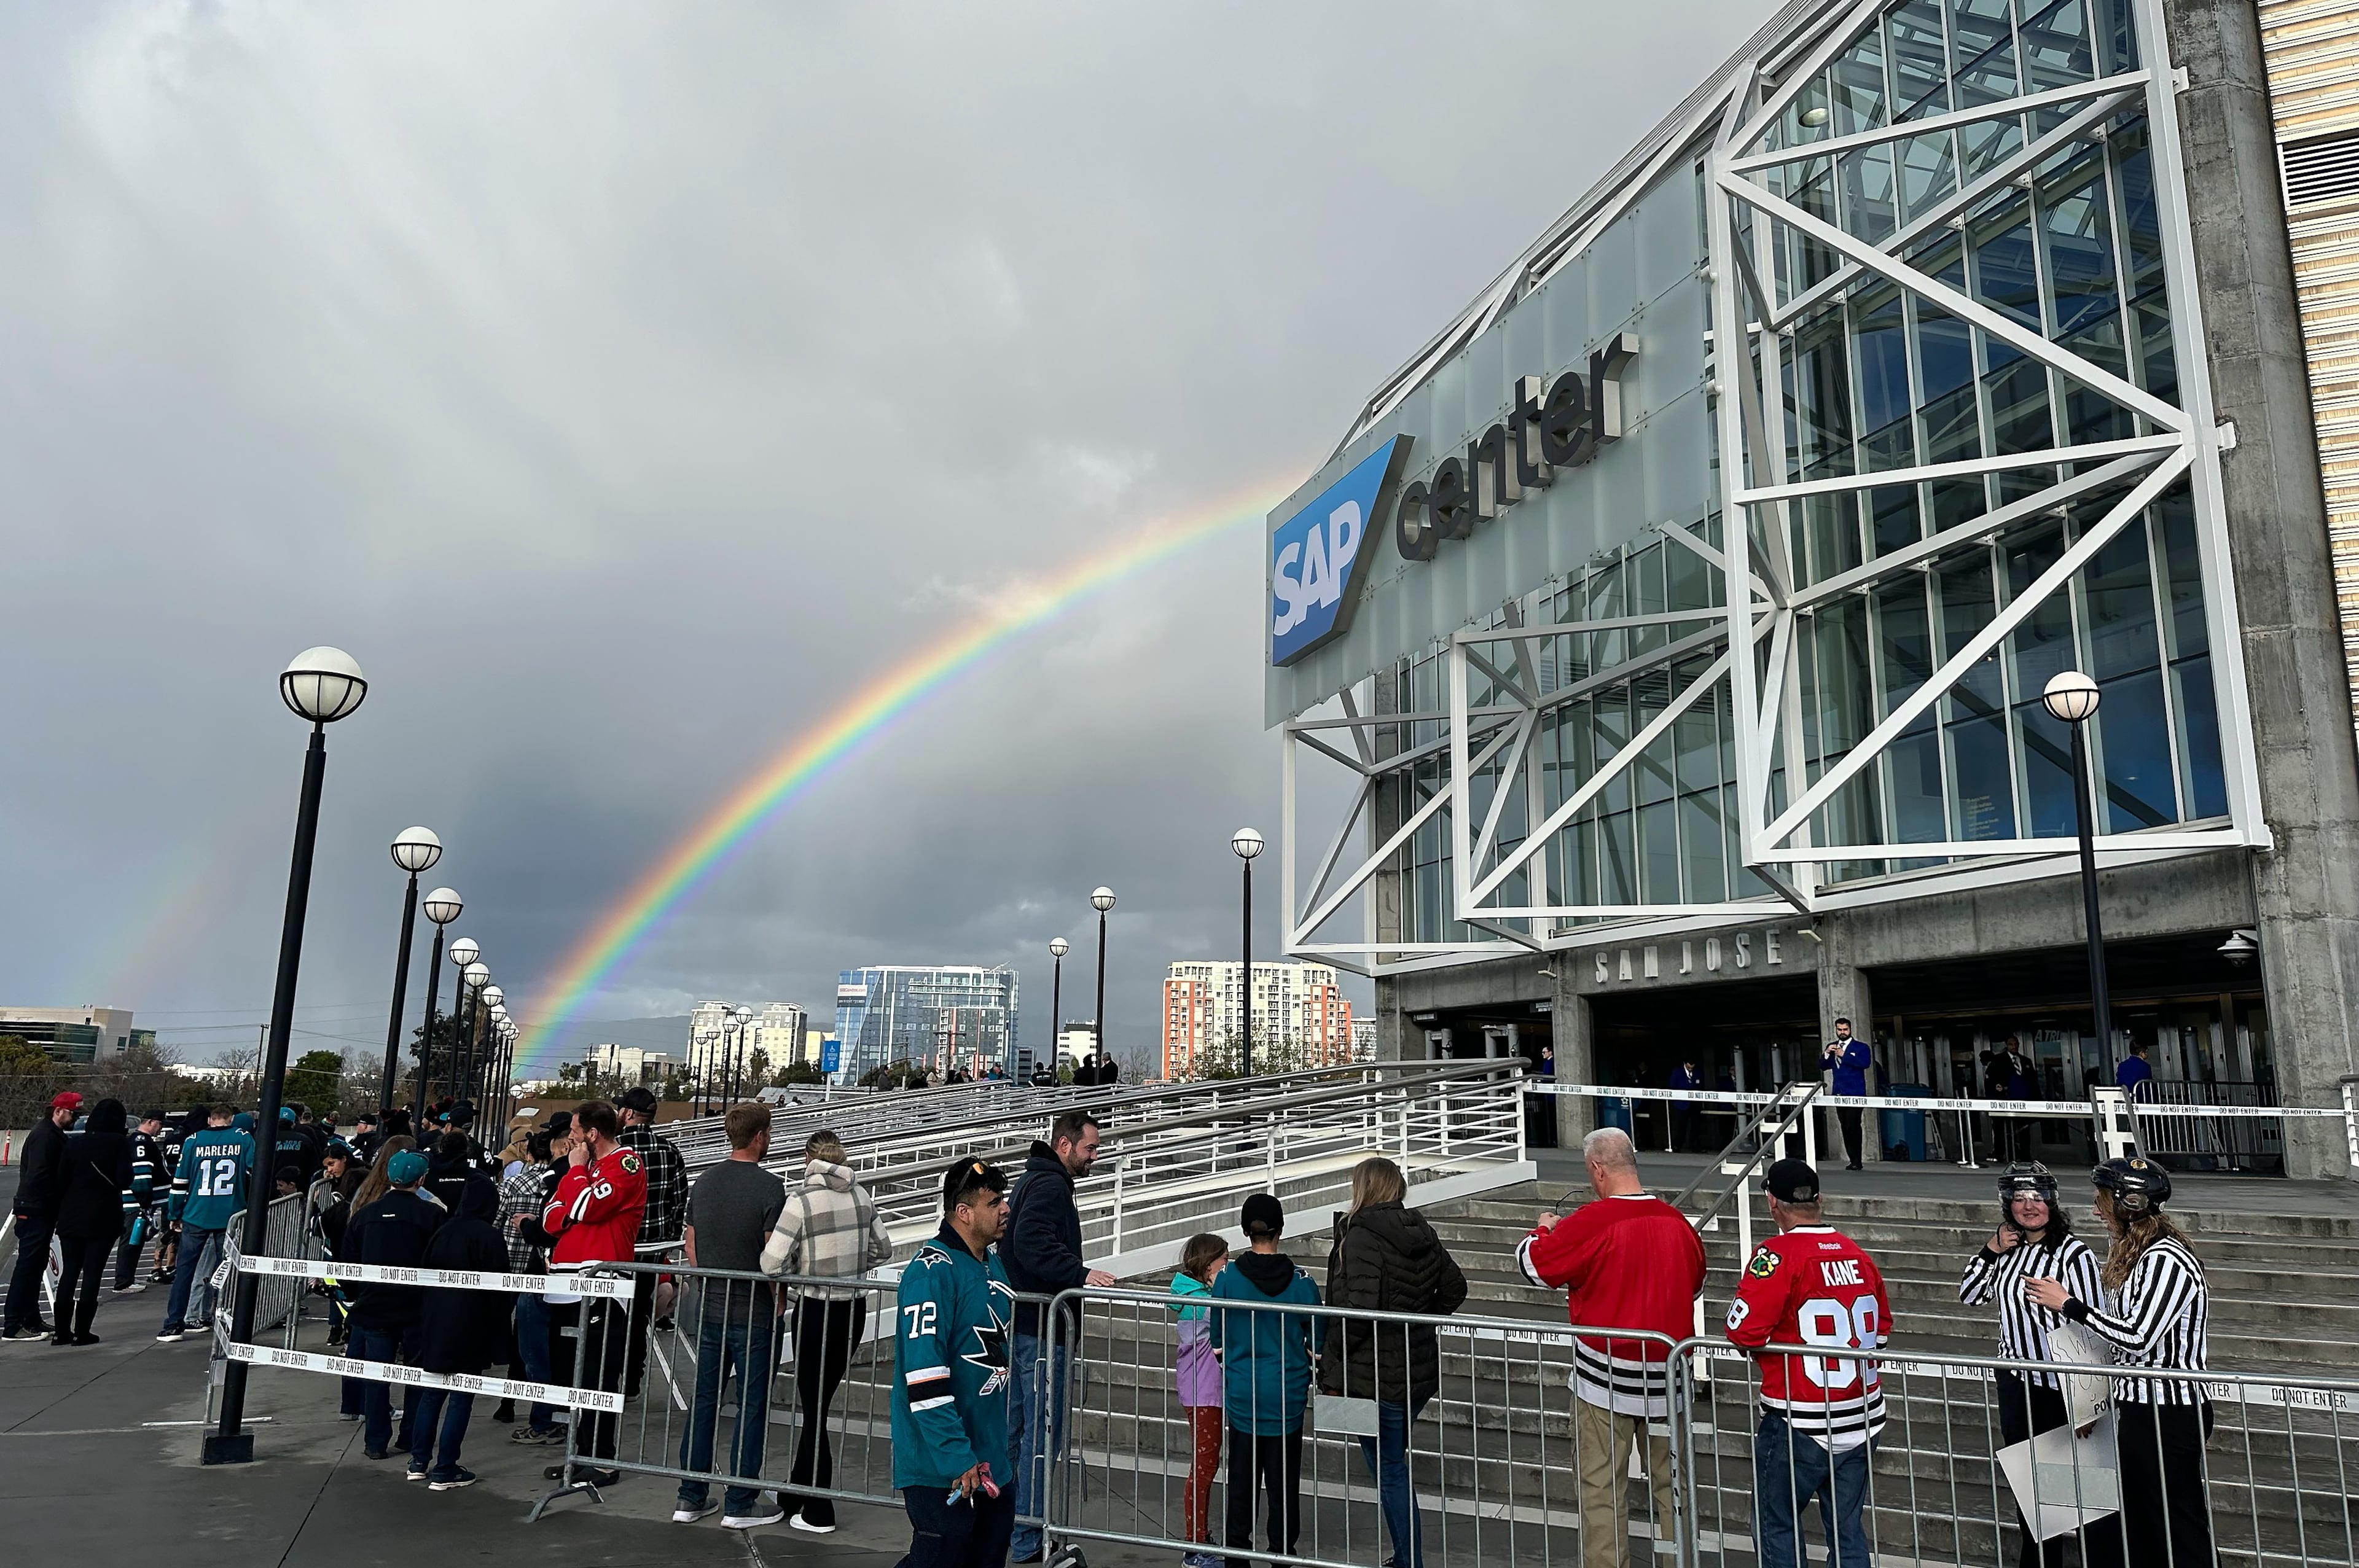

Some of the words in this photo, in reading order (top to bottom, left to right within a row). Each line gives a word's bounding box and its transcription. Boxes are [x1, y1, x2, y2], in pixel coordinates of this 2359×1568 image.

[1396, 332, 1640, 561] center
[1273, 500, 1361, 636] SAP
[1595, 946, 1659, 983] SAN
[1679, 929, 1782, 975] JOSE
[136, 1145, 145, 1156] 6
[166, 1145, 180, 1155] 72
[196, 1145, 241, 1157] MARLEAU
[197, 1159, 235, 1196] 12
[241, 1258, 257, 1270] ENTER
[273, 1260, 280, 1271] DO
[281, 1261, 291, 1272] NOT
[292, 1262, 308, 1273] ENTER
[327, 1264, 333, 1275] DO
[335, 1265, 345, 1276] NOT
[346, 1265, 362, 1277] ENTER
[381, 1268, 388, 1279] DO
[389, 1268, 399, 1281] NOT
[401, 1269, 418, 1282] ENTER
[439, 1271, 447, 1283] DO
[448, 1272, 460, 1284] NOT
[462, 1273, 480, 1286] ENTER
[1820, 1259, 1864, 1287] KANE
[503, 1275, 511, 1287] DO
[512, 1276, 525, 1289] NOT
[526, 1276, 545, 1290] ENTER
[569, 1279, 578, 1291] DO
[580, 1279, 593, 1293] NOT
[595, 1280, 615, 1293] ENTER
[904, 1301, 937, 1339] 72
[1726, 1297, 1750, 1330] 8
[1798, 1295, 1879, 1389] 88
[239, 1346, 254, 1359] ENTER
[272, 1350, 279, 1362] DO
[280, 1351, 290, 1364] NOT
[291, 1352, 307, 1367] ENTER
[327, 1358, 334, 1370] DO
[335, 1359, 345, 1371] NOT
[347, 1360, 364, 1375] ENTER
[383, 1366, 390, 1378] DO
[392, 1367, 402, 1379] NOT
[404, 1368, 421, 1382] ENTER
[443, 1374, 450, 1386] DO
[453, 1375, 463, 1387] NOT
[464, 1376, 482, 1391] ENTER
[504, 1382, 511, 1394] DO
[513, 1383, 524, 1396] NOT
[526, 1384, 545, 1399] ENTER
[2212, 1383, 2231, 1397] TER
[568, 1390, 576, 1402] DO
[579, 1391, 591, 1405] NOT
[593, 1393, 613, 1408] ENTER
[2272, 1388, 2285, 1401] DO
[2289, 1389, 2309, 1404] NOT
